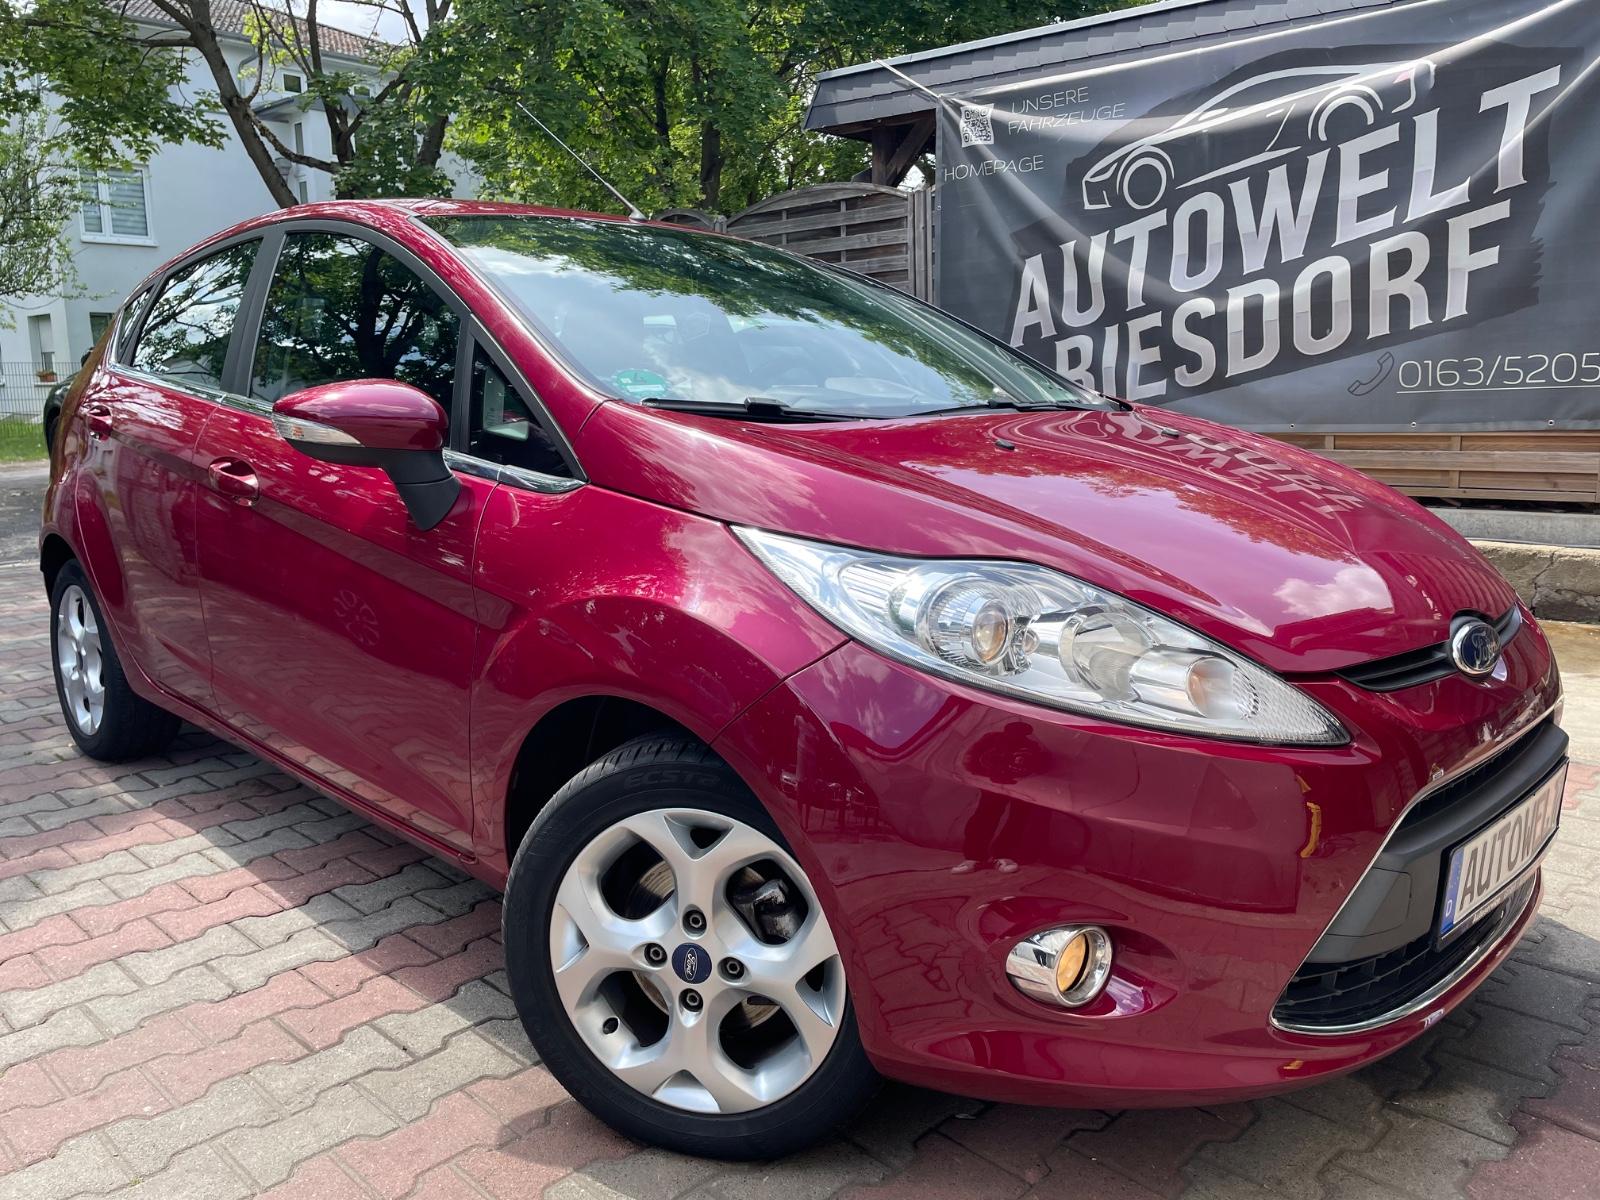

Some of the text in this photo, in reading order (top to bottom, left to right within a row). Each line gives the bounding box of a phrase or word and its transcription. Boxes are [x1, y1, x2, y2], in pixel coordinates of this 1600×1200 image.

[1011, 86, 1089, 113] UNSERE
[1008, 102, 1126, 135] FAHRZEUGE
[943, 154, 1045, 182] HOMEPAGE
[1010, 64, 1561, 348] AUTOWELT
[1055, 199, 1510, 402] BIESDORF
[1398, 352, 1600, 388] 0163/5205
[1445, 899, 1453, 918] D
